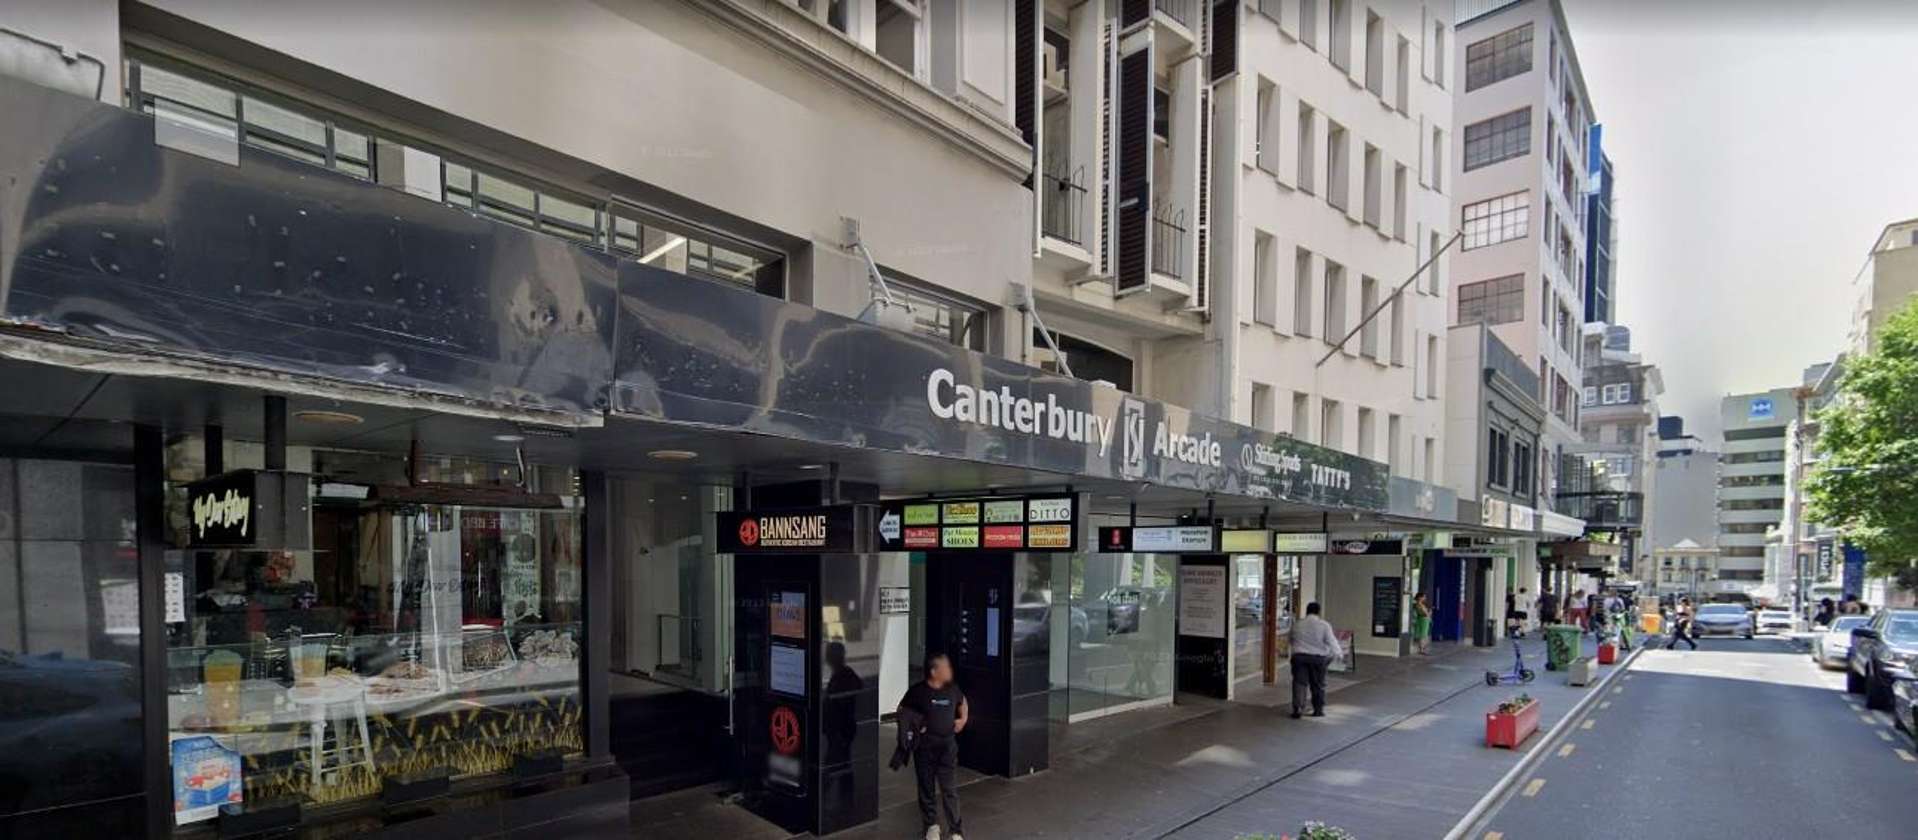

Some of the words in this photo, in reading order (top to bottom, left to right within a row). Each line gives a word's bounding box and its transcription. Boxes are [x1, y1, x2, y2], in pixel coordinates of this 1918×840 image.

[927, 368, 1112, 457] Canterbury
[1153, 421, 1222, 467] Arcade
[1311, 463, 1351, 491] TATTY'S
[1030, 507, 1070, 520] DITTO
[760, 515, 826, 539] BANNSANG
